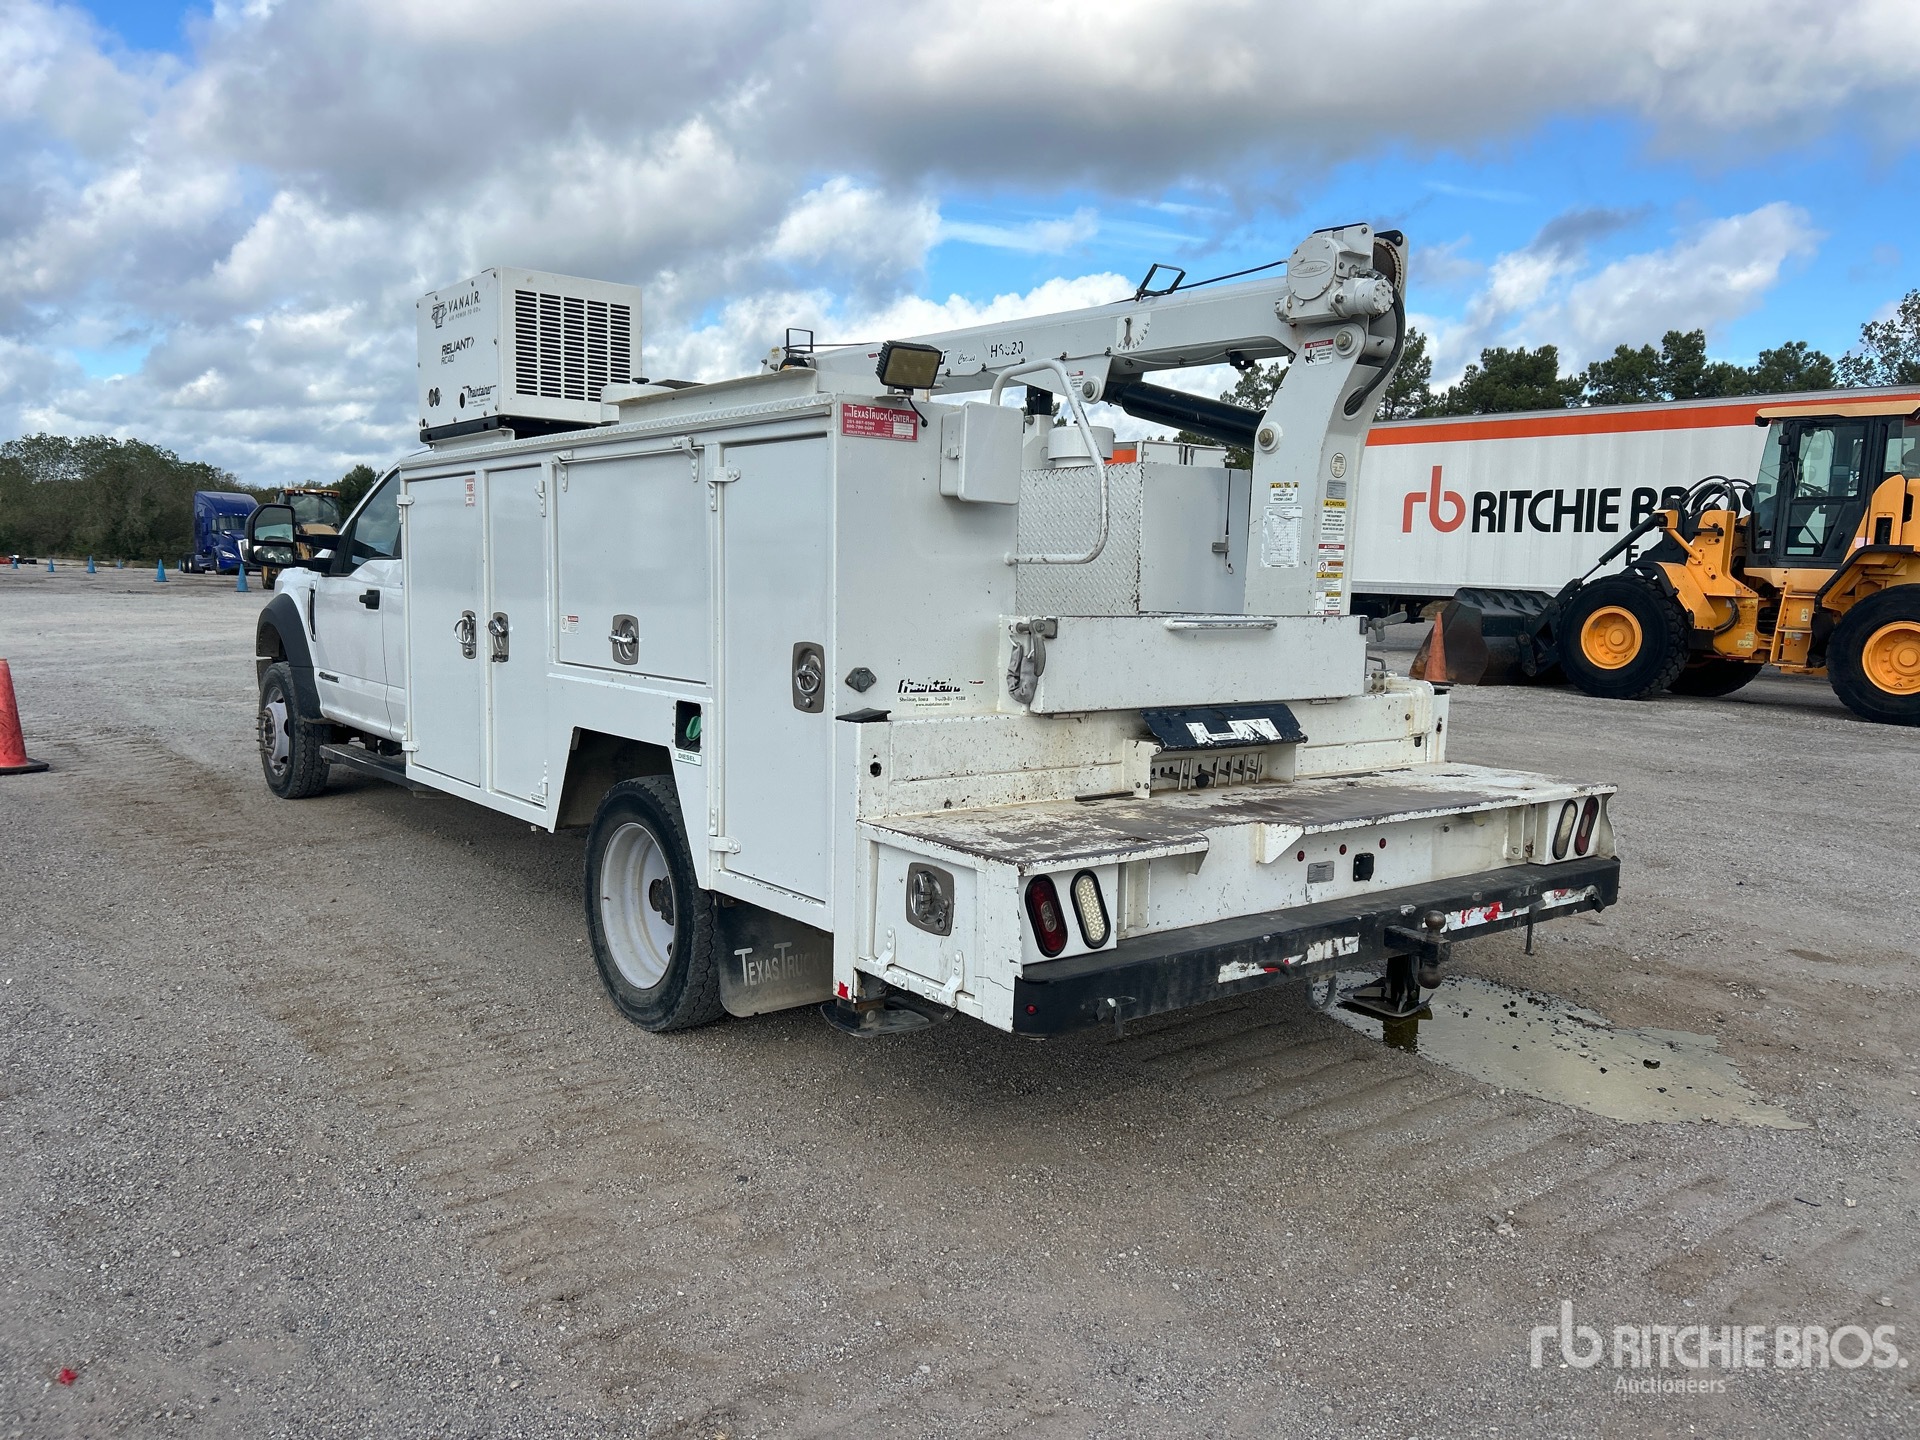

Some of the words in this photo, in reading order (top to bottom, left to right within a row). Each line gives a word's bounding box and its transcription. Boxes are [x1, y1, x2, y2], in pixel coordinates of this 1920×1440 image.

[449, 291, 480, 313] VANAIR
[442, 336, 471, 356] RELIANT
[1471, 488, 1621, 533] RITCHIE
[678, 753, 696, 762] DIESEL
